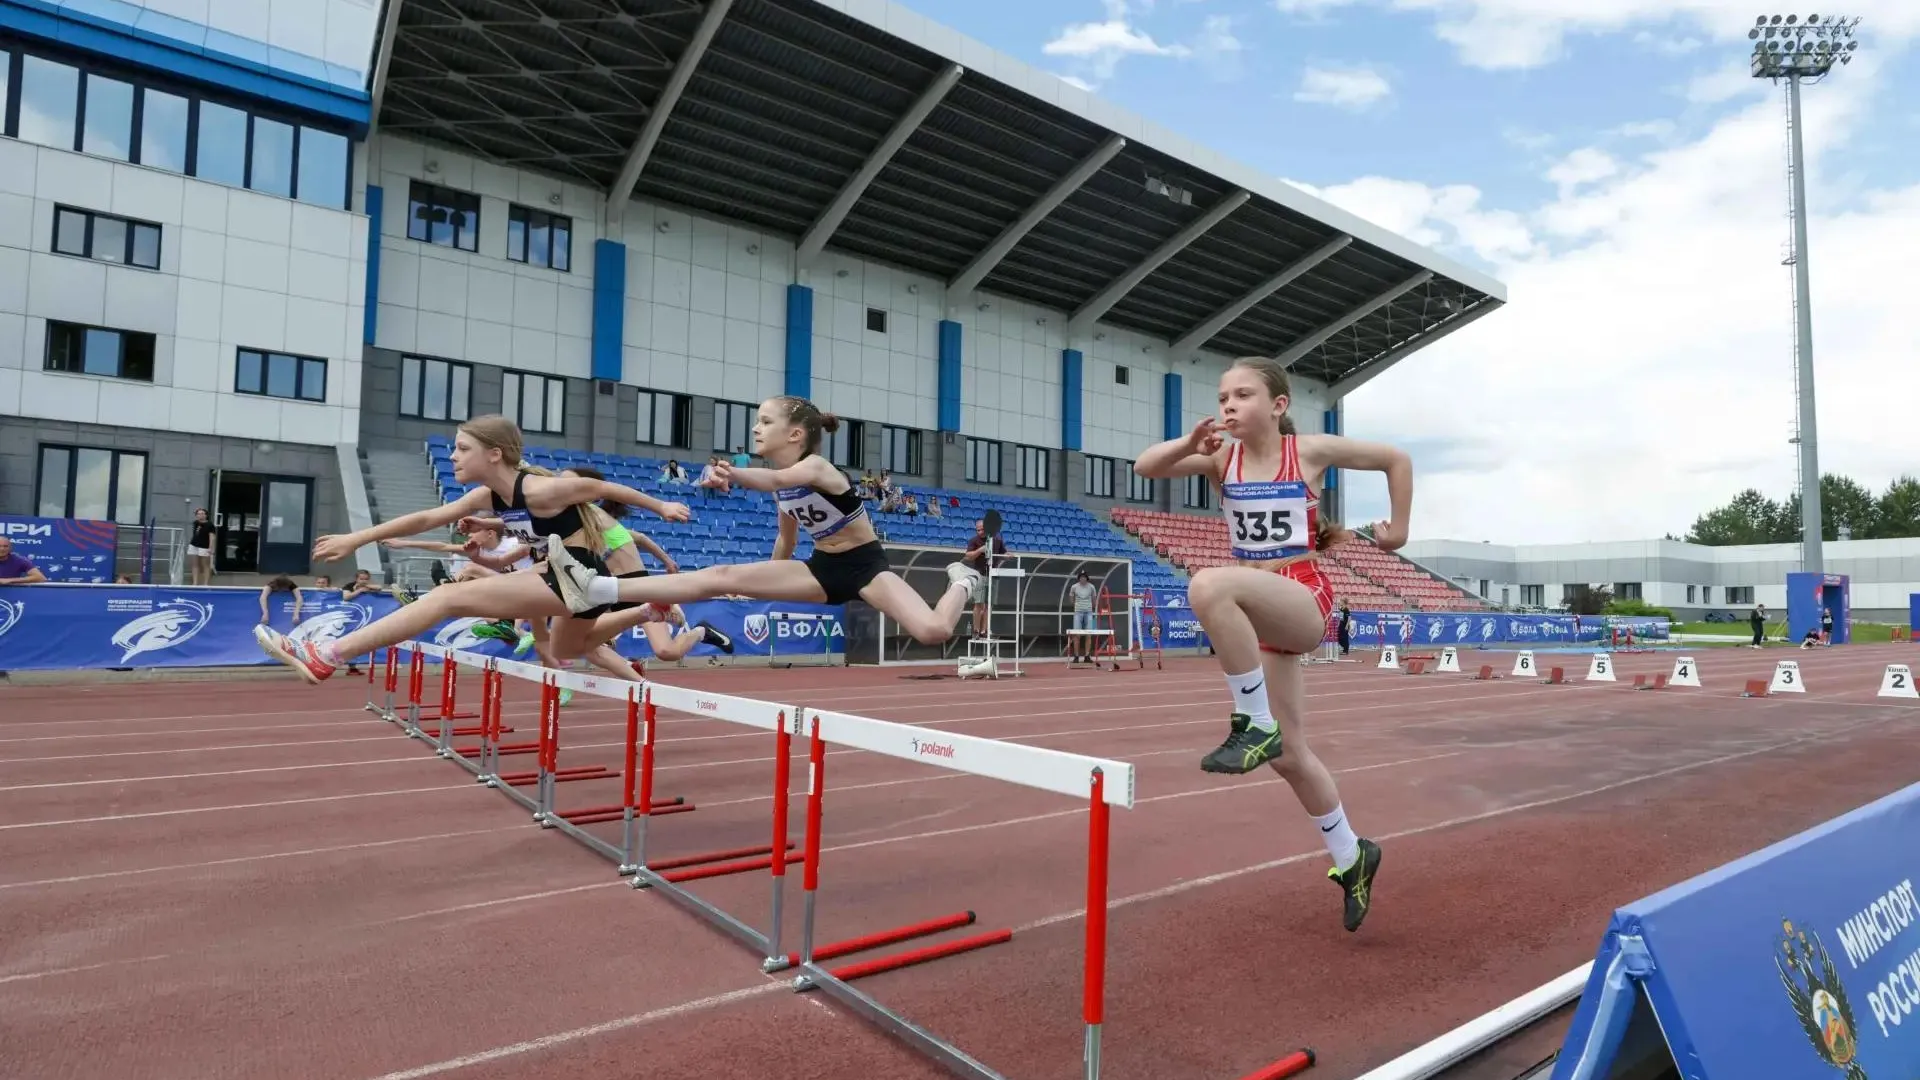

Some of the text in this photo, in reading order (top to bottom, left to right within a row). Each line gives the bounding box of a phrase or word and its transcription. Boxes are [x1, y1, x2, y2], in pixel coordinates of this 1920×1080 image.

[1232, 510, 1293, 542] 335
[777, 621, 845, 638] ВФЛА
[1168, 631, 1197, 639] РОССИИ
[1385, 652, 1392, 662] 8
[1445, 653, 1453, 664] 7
[1520, 657, 1529, 669] 6
[1596, 662, 1606, 674] 5
[1678, 665, 1689, 679] 4
[1782, 670, 1794, 684] 3
[1891, 674, 1905, 689] 2
[920, 741, 955, 758] polanik
[1836, 879, 1920, 969] МИНСПОРТ
[1867, 947, 1920, 1038] РОССИ
